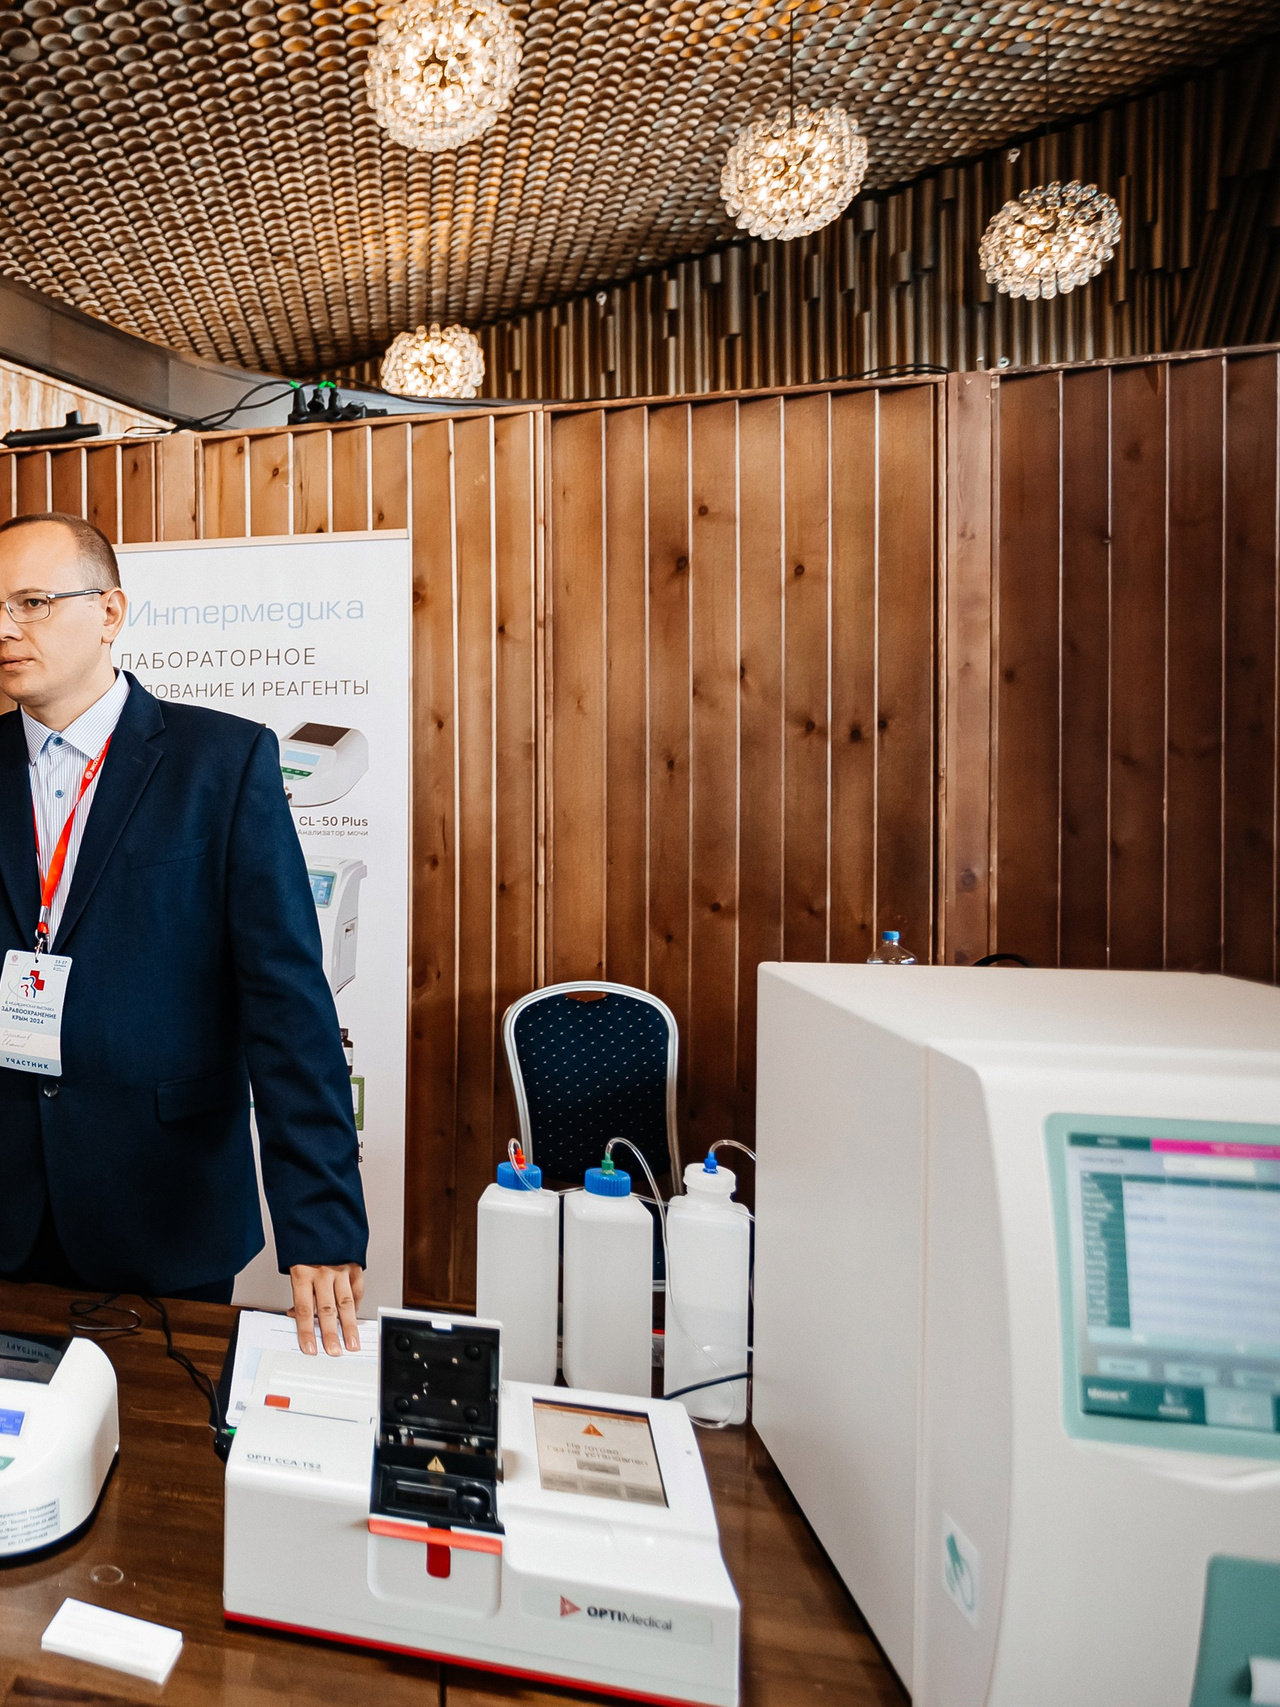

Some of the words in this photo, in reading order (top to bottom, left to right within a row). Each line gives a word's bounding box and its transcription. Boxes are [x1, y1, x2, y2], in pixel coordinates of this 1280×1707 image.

[128, 600, 364, 630] Интермедика
[120, 647, 317, 671] ЛАБОРАТОРНОЕ
[242, 682, 255, 697] И
[262, 680, 369, 696] РЕАГЕНТЫ
[299, 816, 338, 827] CL-50
[341, 816, 369, 827] Plus
[298, 829, 345, 838] Анализатор
[0, 1005, 57, 1020] ЗДРАВООХРАНЕНИЕ
[11, 1014, 28, 1022] КРЫМ
[29, 1017, 45, 1025] 2024
[5, 1057, 49, 1069] УЧАСТНИК
[247, 1453, 271, 1461] OPTI
[586, 1605, 672, 1630] OPTIMedical
